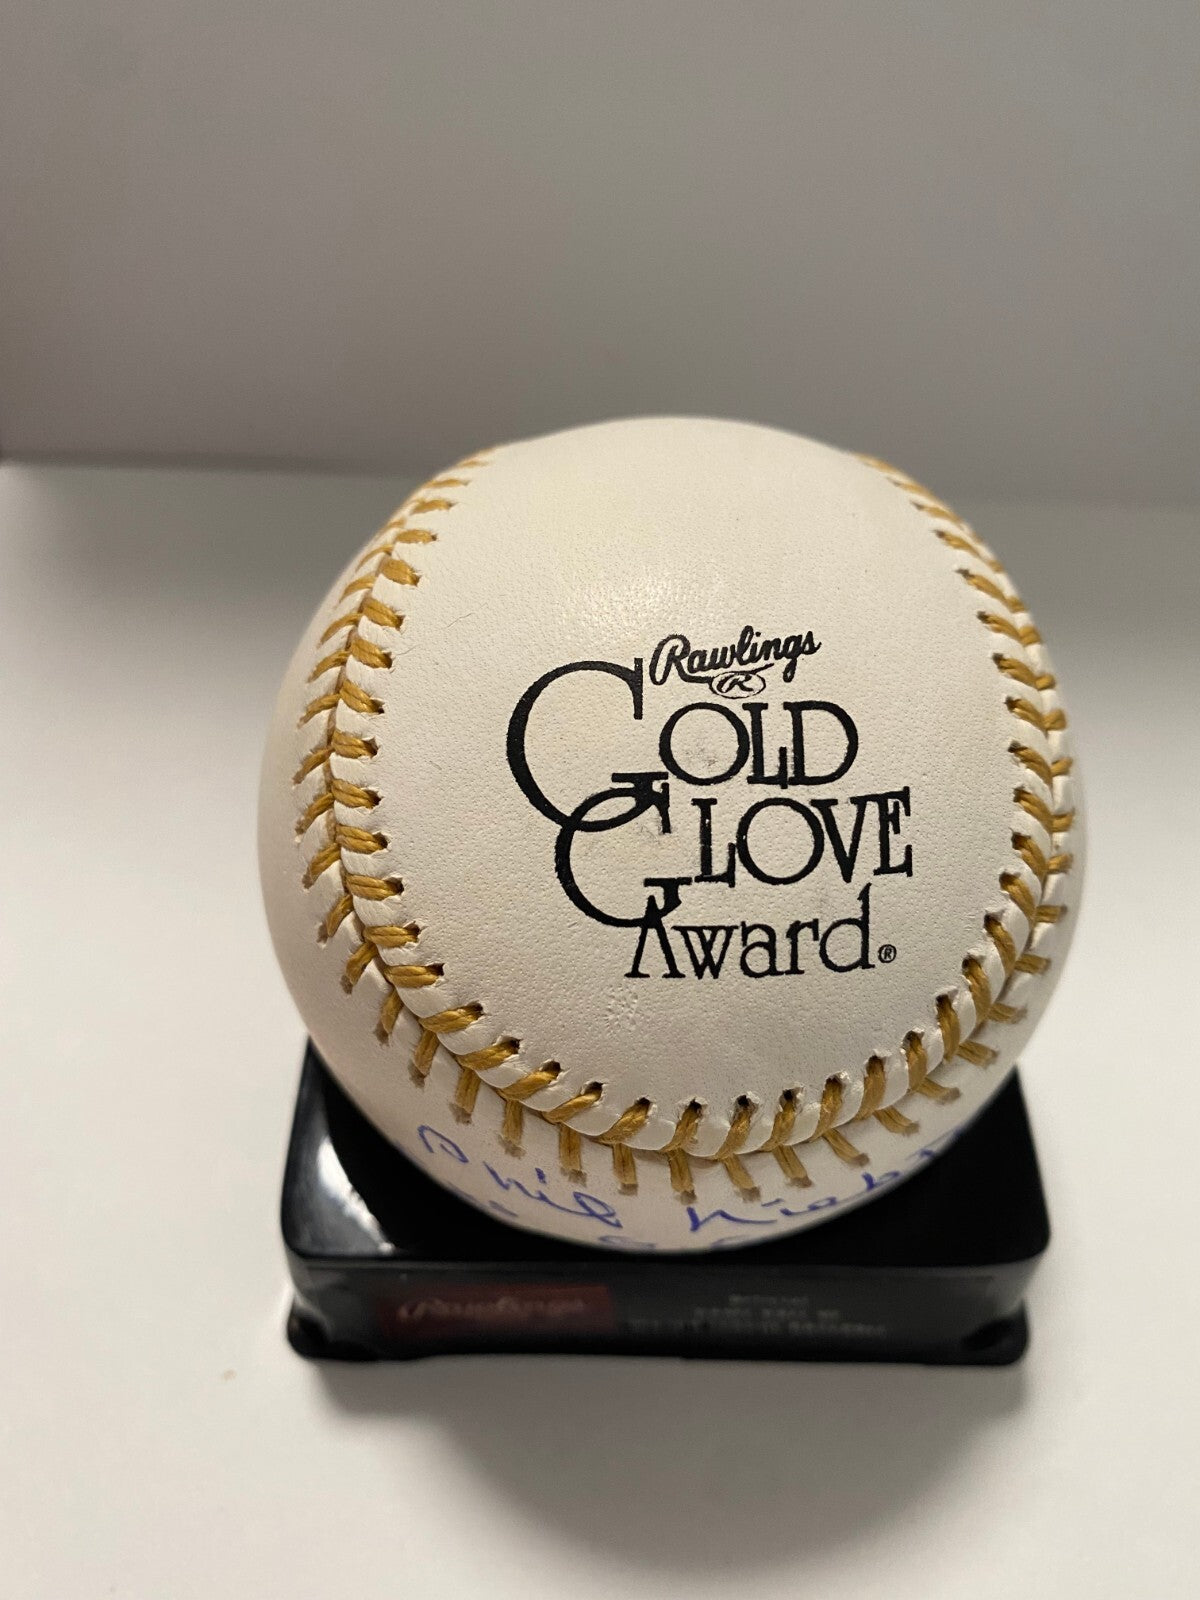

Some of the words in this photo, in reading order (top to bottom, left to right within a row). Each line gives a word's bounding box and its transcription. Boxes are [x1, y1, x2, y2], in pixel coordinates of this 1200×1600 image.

[650, 626, 821, 684] Rawlings
[507, 658, 858, 832] GOLD
[555, 782, 913, 928] GLOVE
